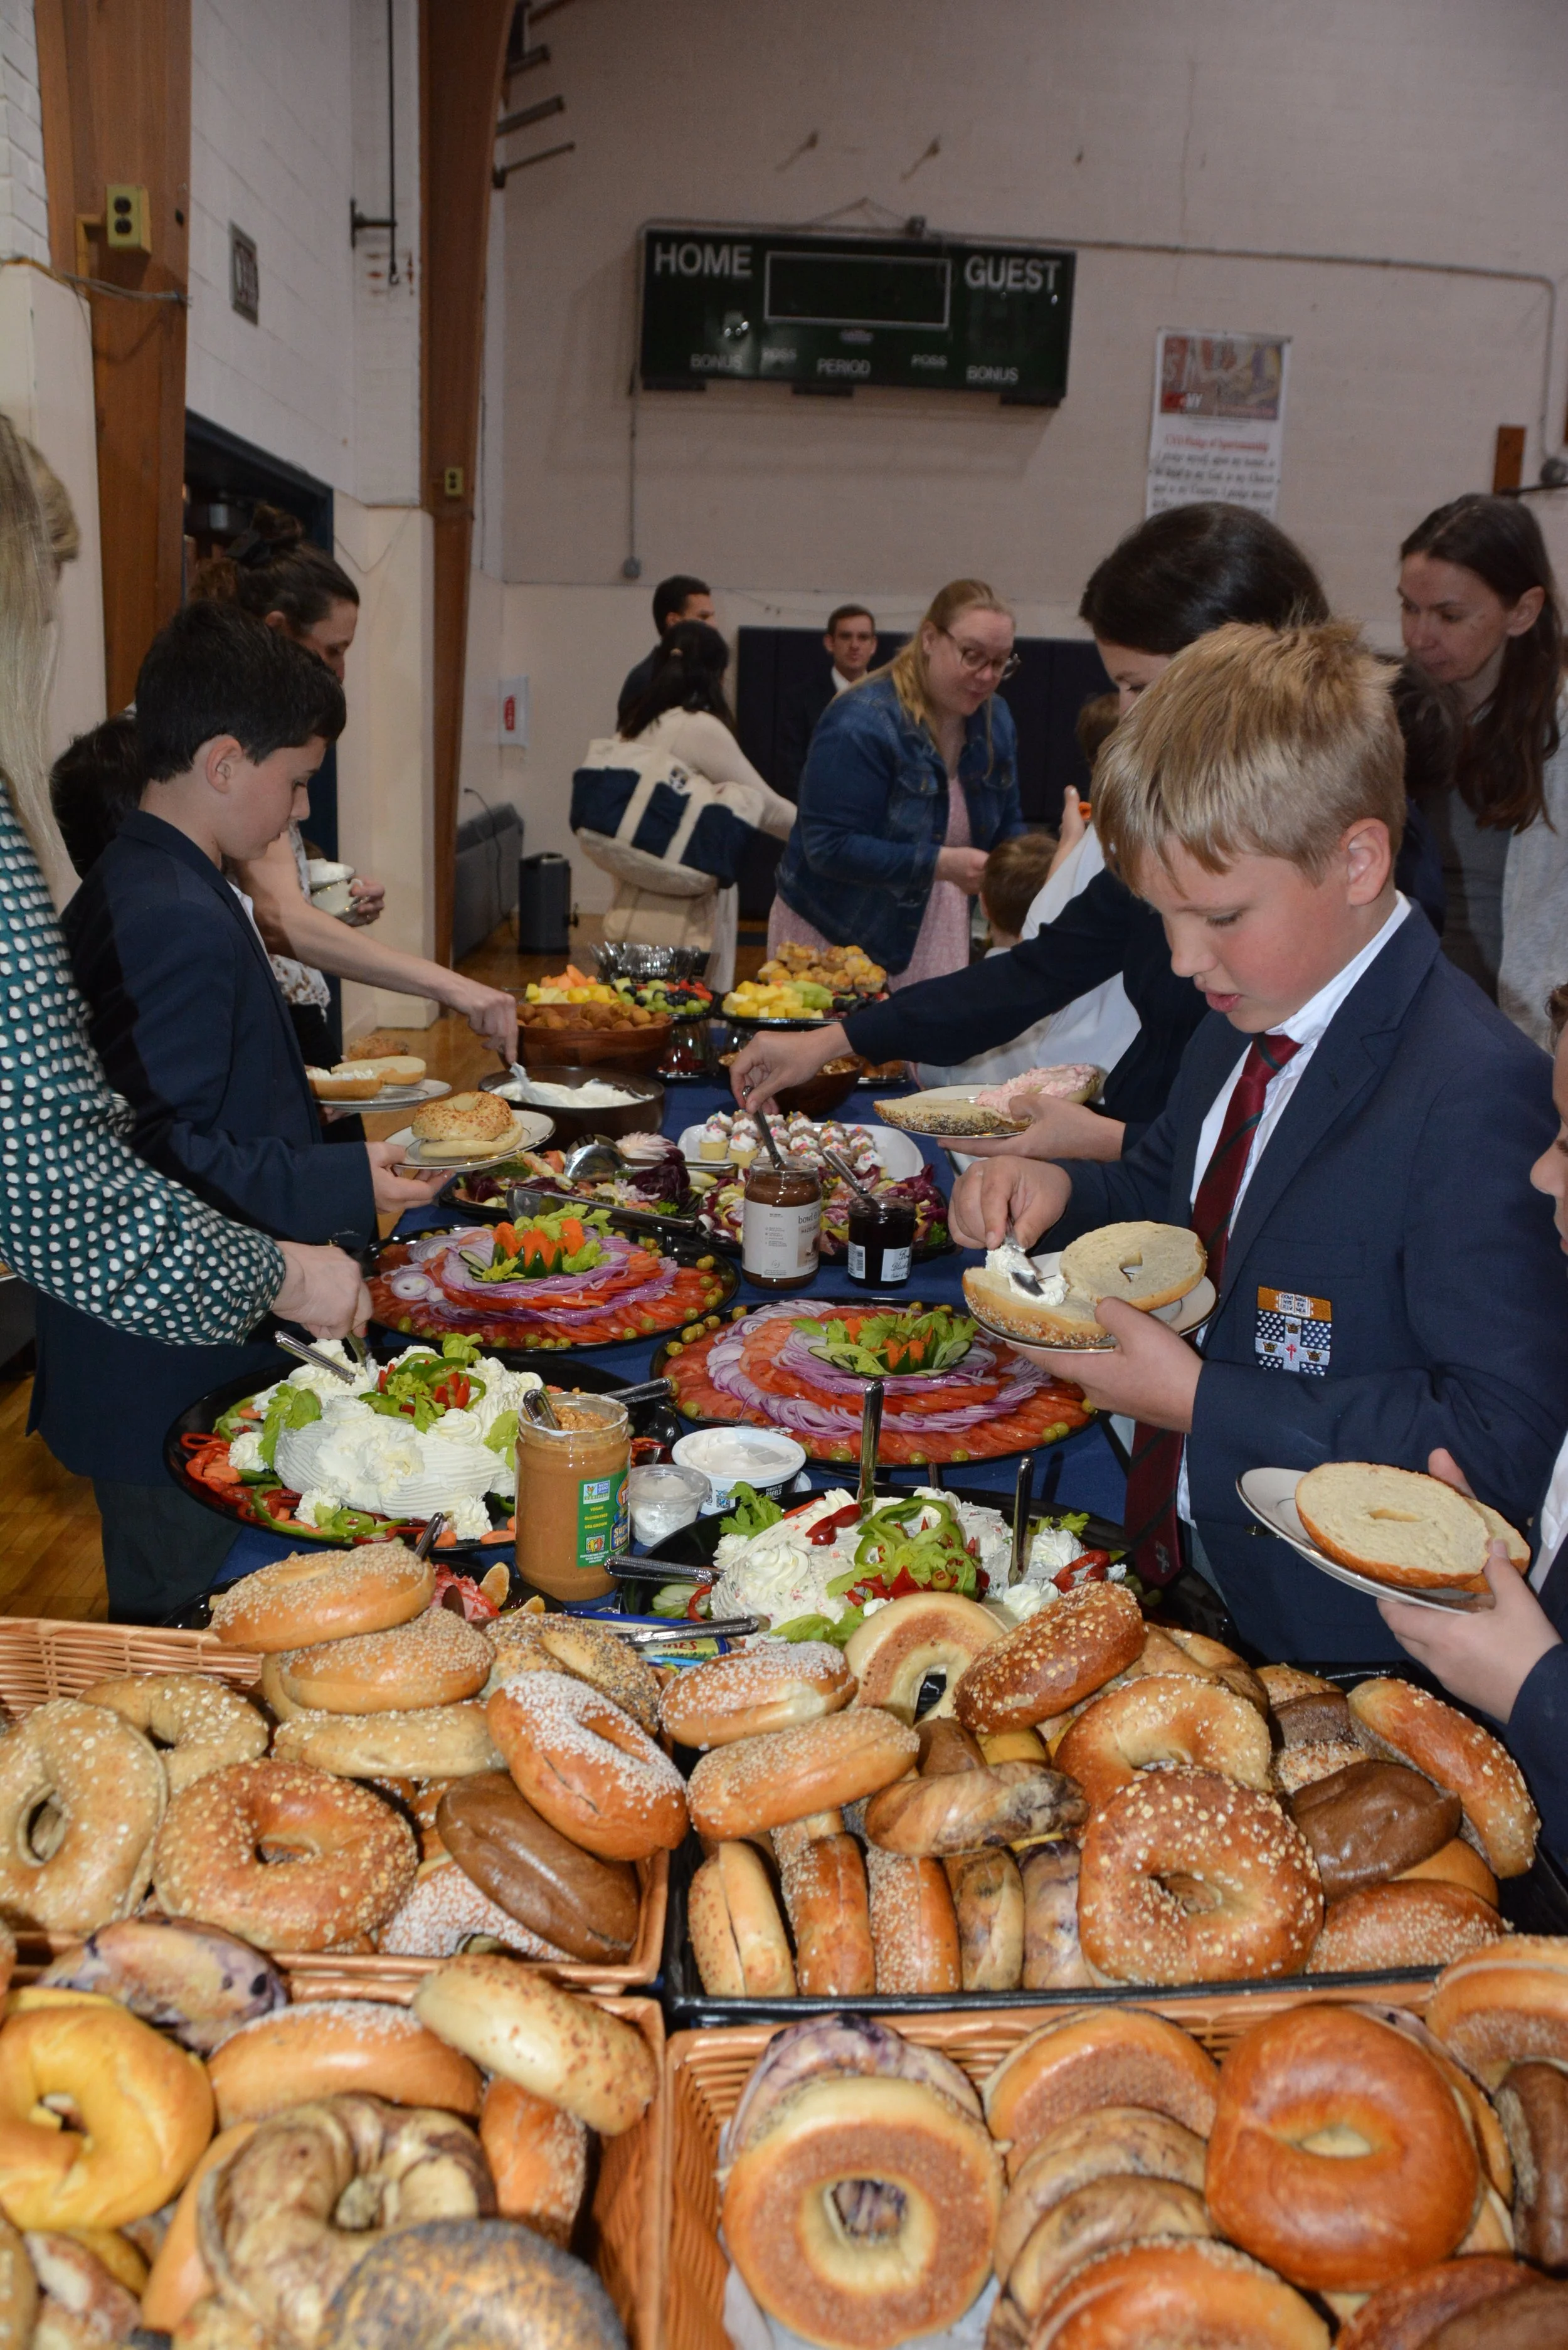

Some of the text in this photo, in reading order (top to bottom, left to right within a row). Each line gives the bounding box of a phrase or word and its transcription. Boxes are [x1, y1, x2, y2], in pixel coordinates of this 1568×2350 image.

[654, 243, 753, 278] HOME
[965, 255, 1061, 291] GUEST
[691, 353, 743, 370] BONUS
[817, 358, 871, 376] PERIOD
[967, 365, 1019, 383] BONUS
[766, 1488, 782, 1497] BAGELS
